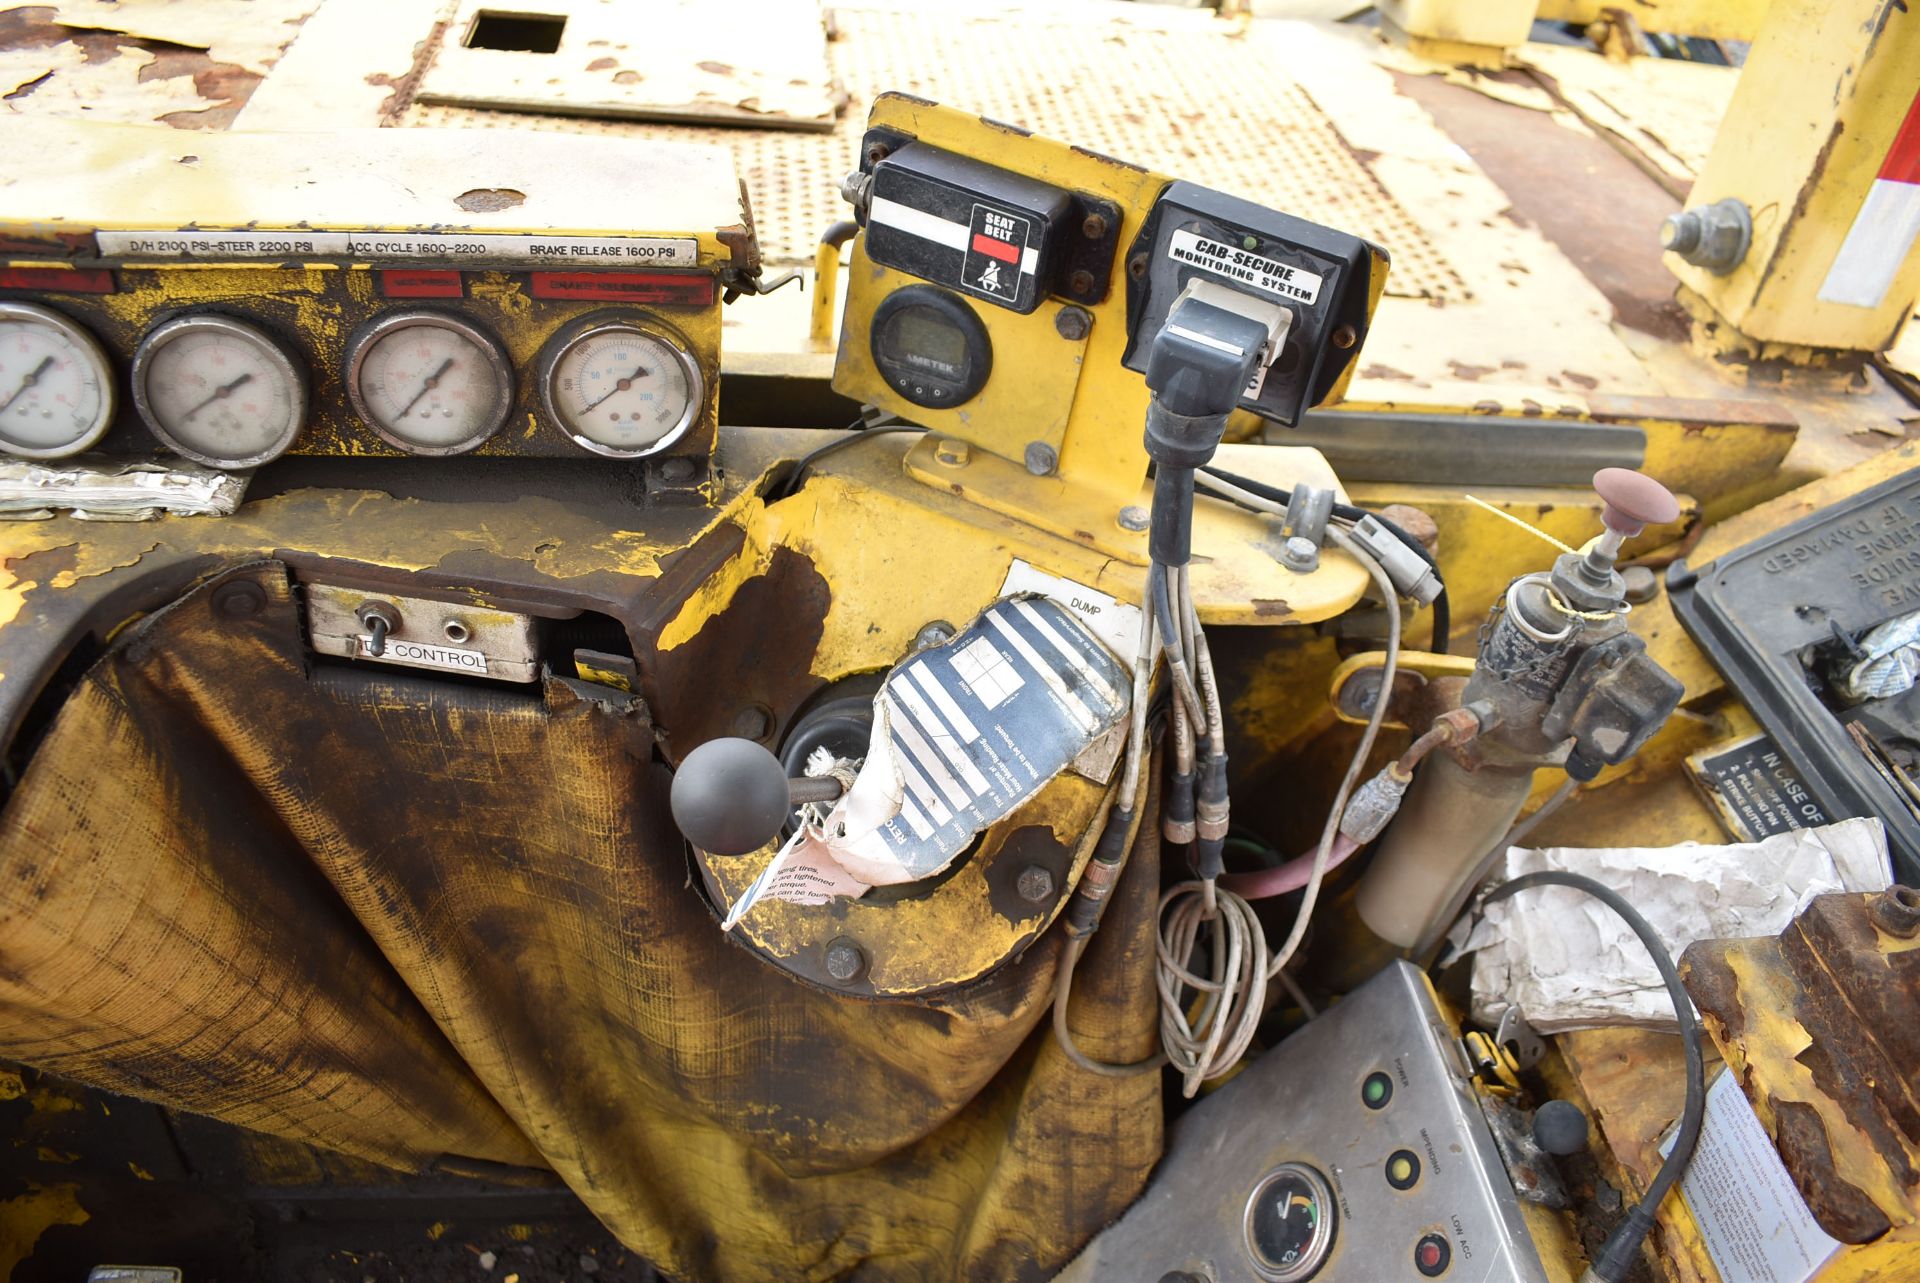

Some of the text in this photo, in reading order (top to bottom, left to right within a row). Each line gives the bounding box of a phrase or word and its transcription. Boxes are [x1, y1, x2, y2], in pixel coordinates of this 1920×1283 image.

[985, 212, 1015, 231] SEAT
[984, 224, 1012, 241] BELT
[130, 241, 313, 252] D/H 2100 PSI-STEER 2200 PSI
[346, 242, 486, 254] ACC CYCLE 1600-2200
[530, 245, 676, 257] BRAKE RELEASE 1600 PSI
[1195, 240, 1295, 281] CAB-SECURE
[1174, 248, 1312, 301] MONITORING SYSTEM
[906, 353, 954, 372] AMETEK
[1763, 520, 1872, 574] DAMAGED
[1070, 597, 1101, 616] DUMP
[1056, 616, 1085, 643] Supervisor
[395, 644, 487, 668] CONTROL
[1090, 648, 1108, 667] Return
[958, 680, 972, 696] FRONT
[1012, 746, 1021, 756] be
[1017, 753, 1027, 763] to
[997, 761, 1012, 779] Meter
[1023, 760, 1040, 779] Wheel
[1009, 776, 1023, 792] Hour
[1762, 752, 1824, 822] IN CASE OF
[992, 794, 1004, 808] Tire
[1723, 778, 1746, 806] STRIKE
[1742, 805, 1770, 836] BUTTON
[1737, 774, 1755, 794] PULL
[1764, 811, 1779, 826] PIN
[973, 809, 985, 822] Unit
[799, 866, 818, 874] tires,
[794, 874, 835, 887] tightened
[1394, 1058, 1410, 1088] POWER
[1420, 1128, 1441, 1175] IMPENDING
[1451, 1214, 1472, 1259] LOW ACC
